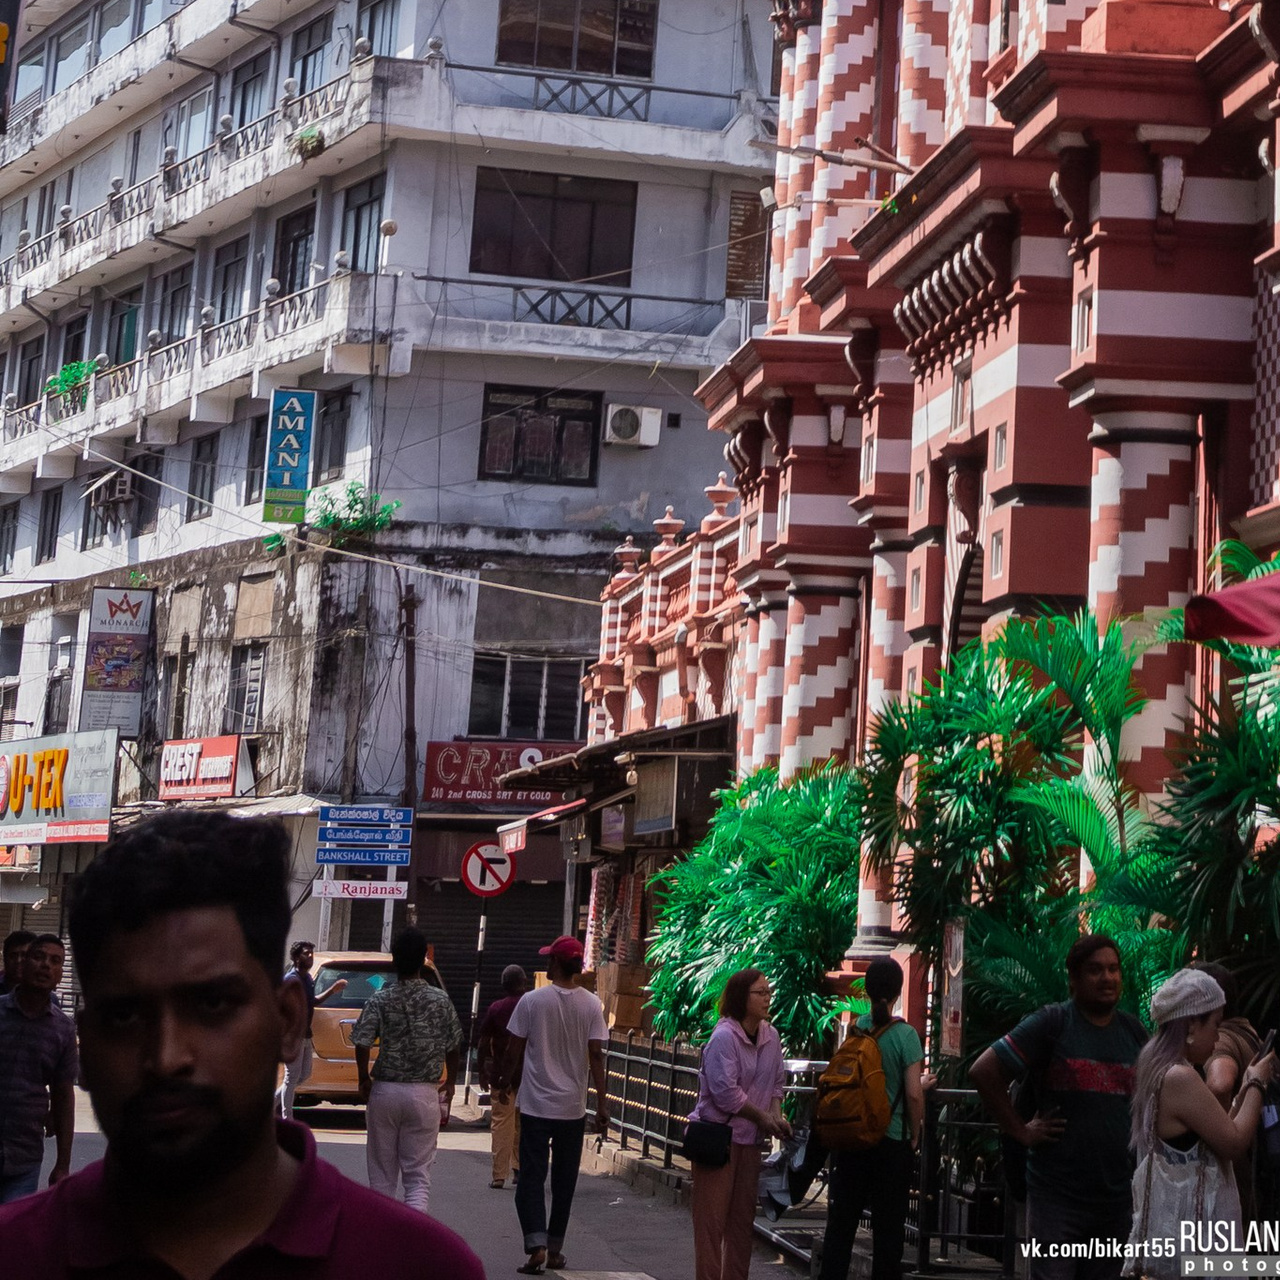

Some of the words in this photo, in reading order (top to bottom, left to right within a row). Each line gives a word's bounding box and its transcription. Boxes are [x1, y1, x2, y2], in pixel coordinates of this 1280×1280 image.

[278, 396, 306, 486] AMANI
[99, 619, 149, 628] MONARCH
[161, 742, 204, 782] CREST
[10, 748, 69, 814] U-TEX
[447, 789, 463, 800] 2nd
[465, 790, 492, 800] CROSS
[318, 850, 370, 861] BANKSHALL
[373, 851, 408, 862] STREET
[341, 882, 403, 898] Ranjanas
